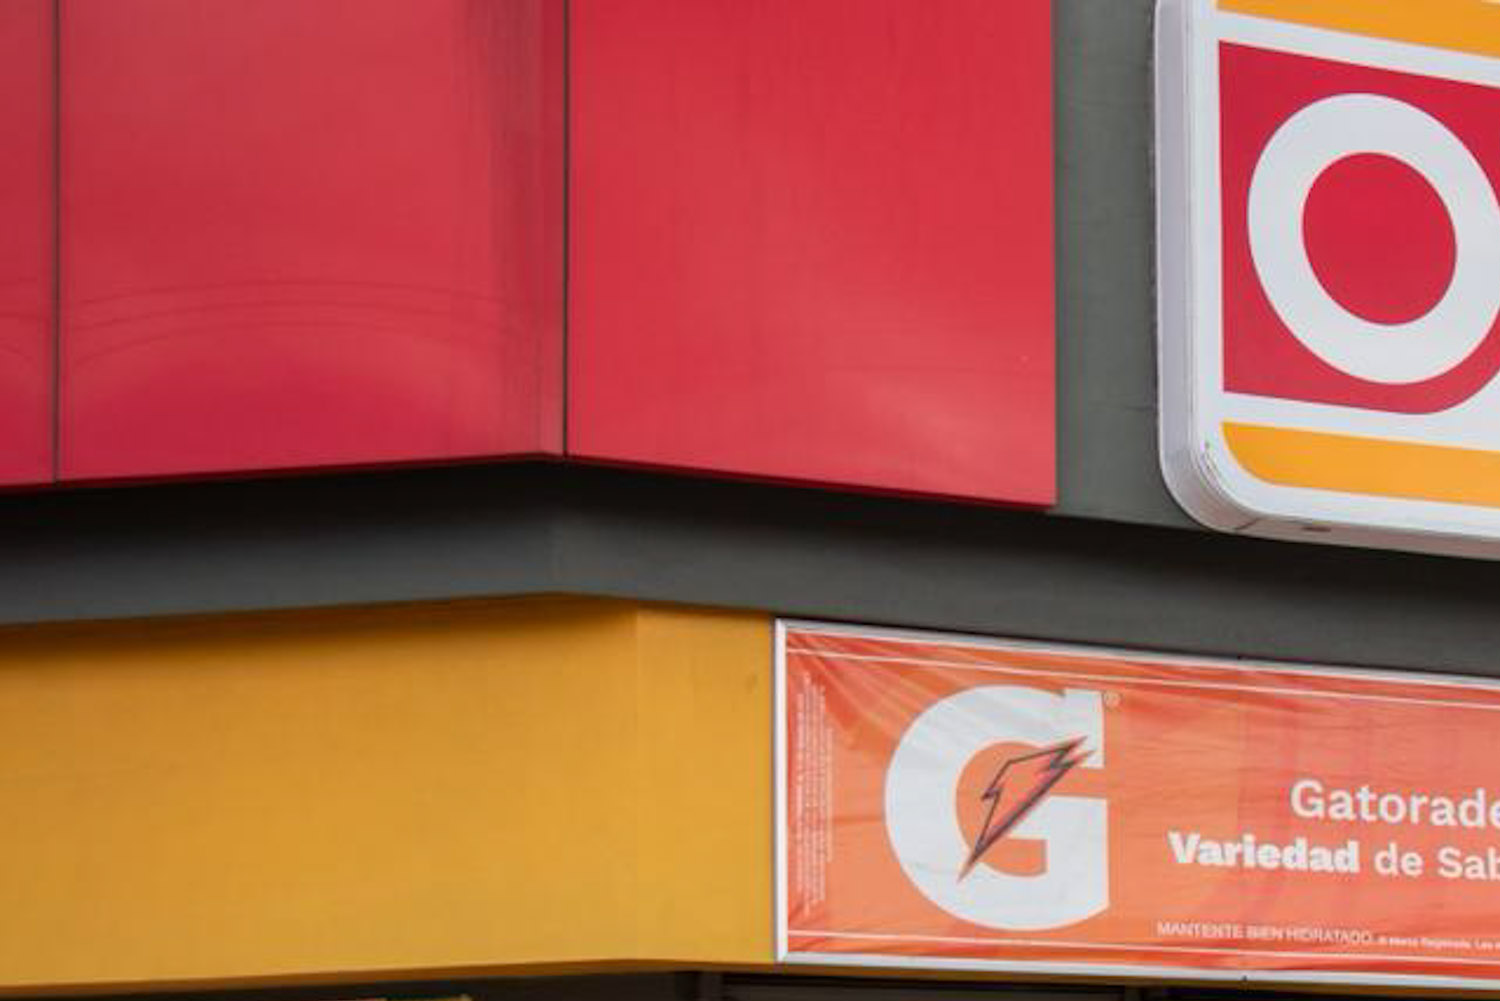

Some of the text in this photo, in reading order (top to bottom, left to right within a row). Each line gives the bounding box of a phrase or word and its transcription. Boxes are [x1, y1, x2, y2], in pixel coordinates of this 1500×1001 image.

[1167, 831, 1360, 875] Variedad
[1374, 843, 1422, 877] de
[1157, 921, 1243, 939] MANTENTE
[1247, 924, 1283, 940] BIEN
